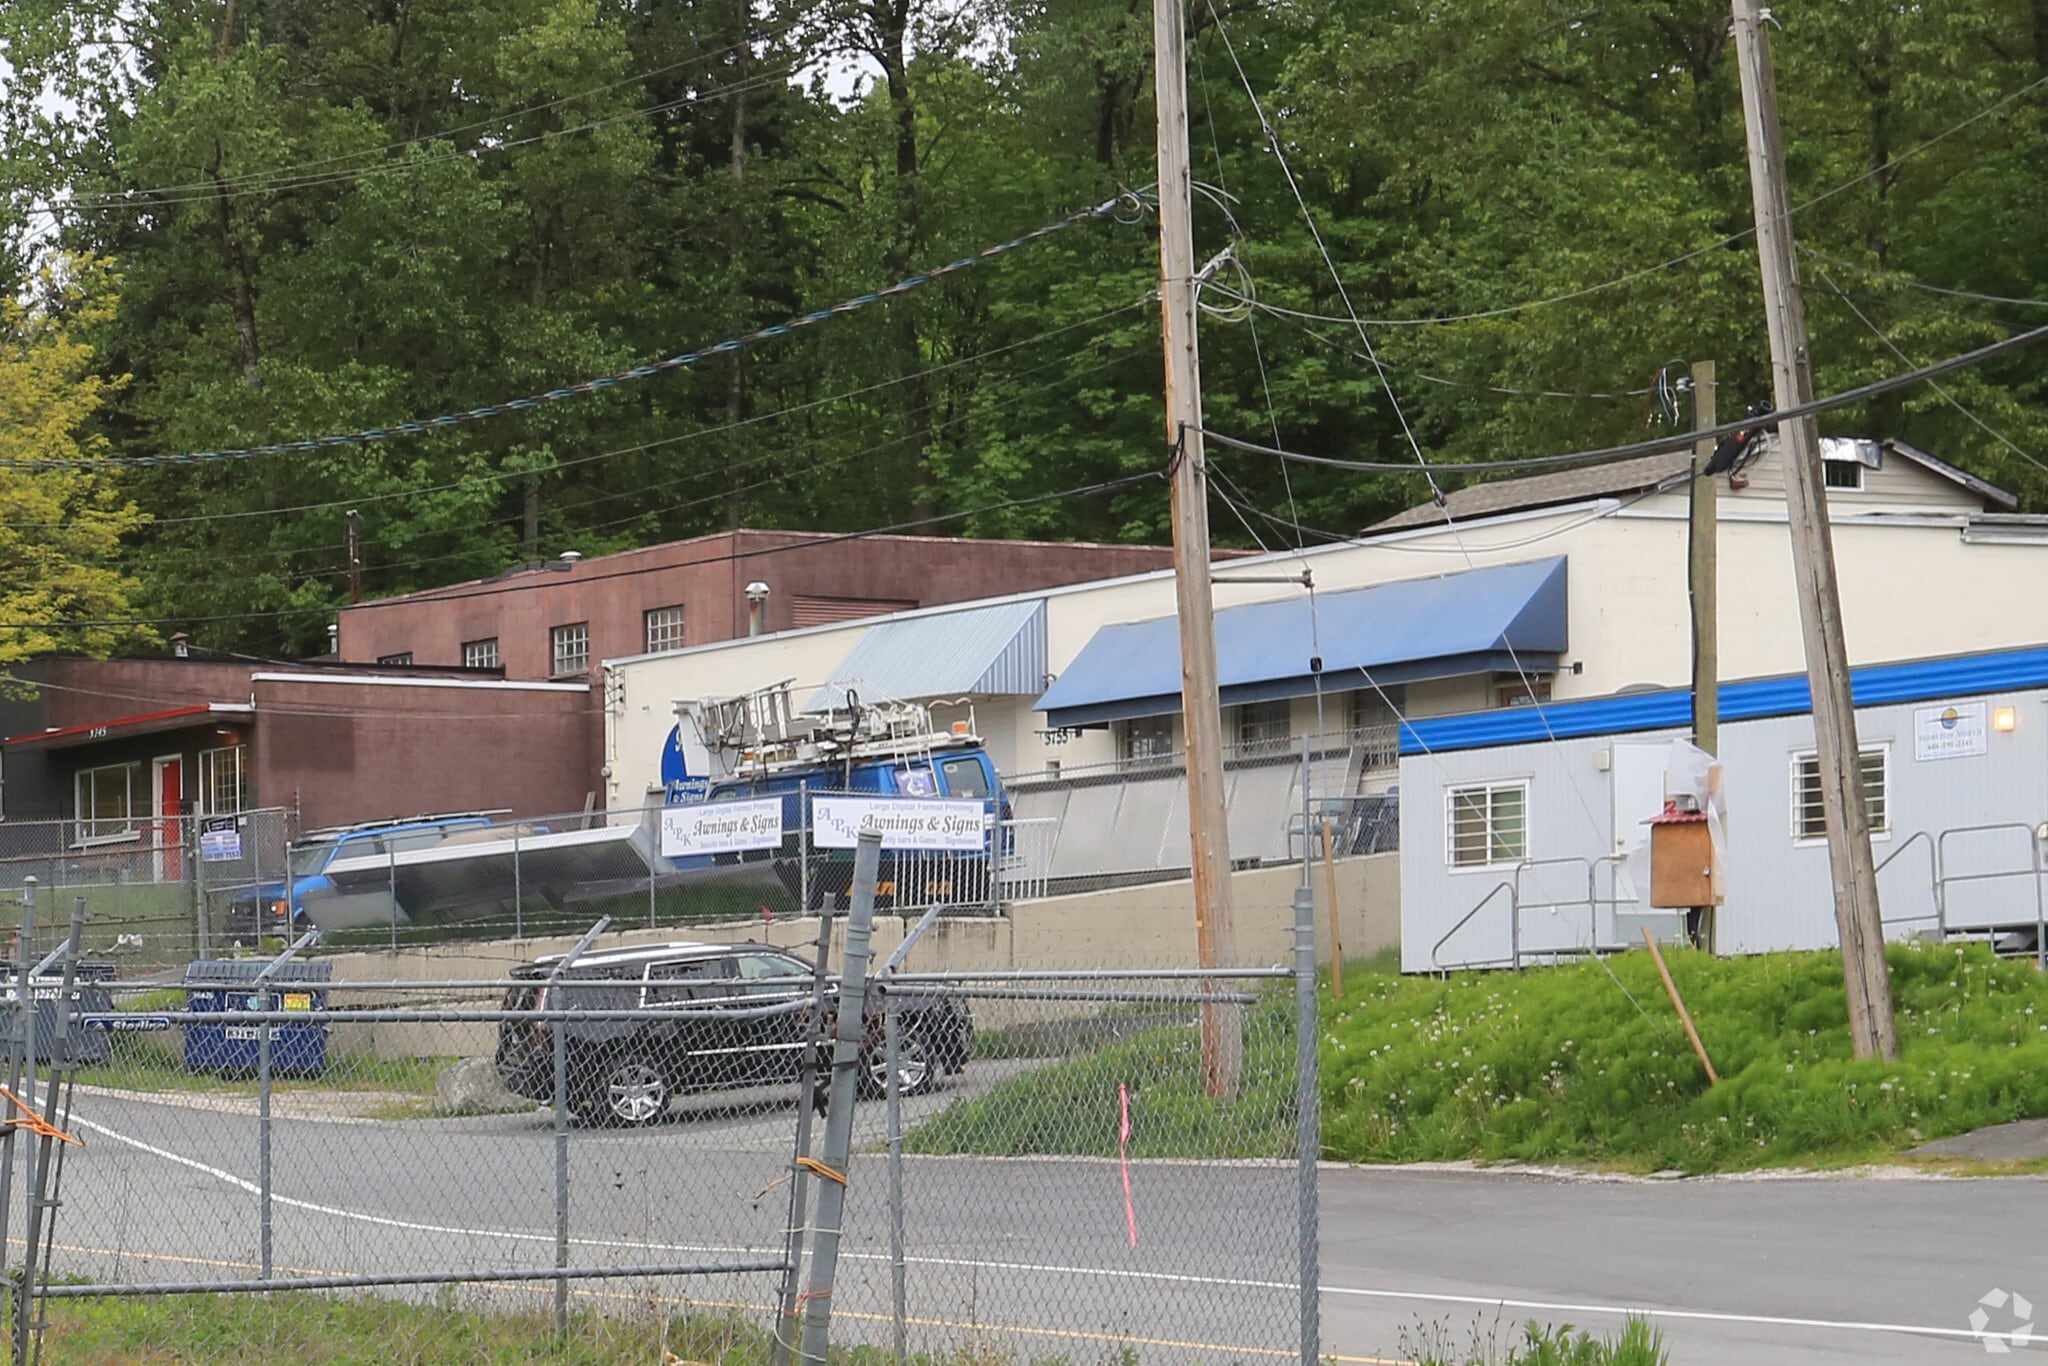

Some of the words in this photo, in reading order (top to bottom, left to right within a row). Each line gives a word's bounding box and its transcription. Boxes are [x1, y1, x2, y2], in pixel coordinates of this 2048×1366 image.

[693, 817, 737, 837] Awnings
[739, 817, 750, 832] &
[751, 813, 779, 834] Signs
[861, 814, 924, 835] Awnings
[927, 816, 940, 831] &
[943, 815, 980, 837] Signs
